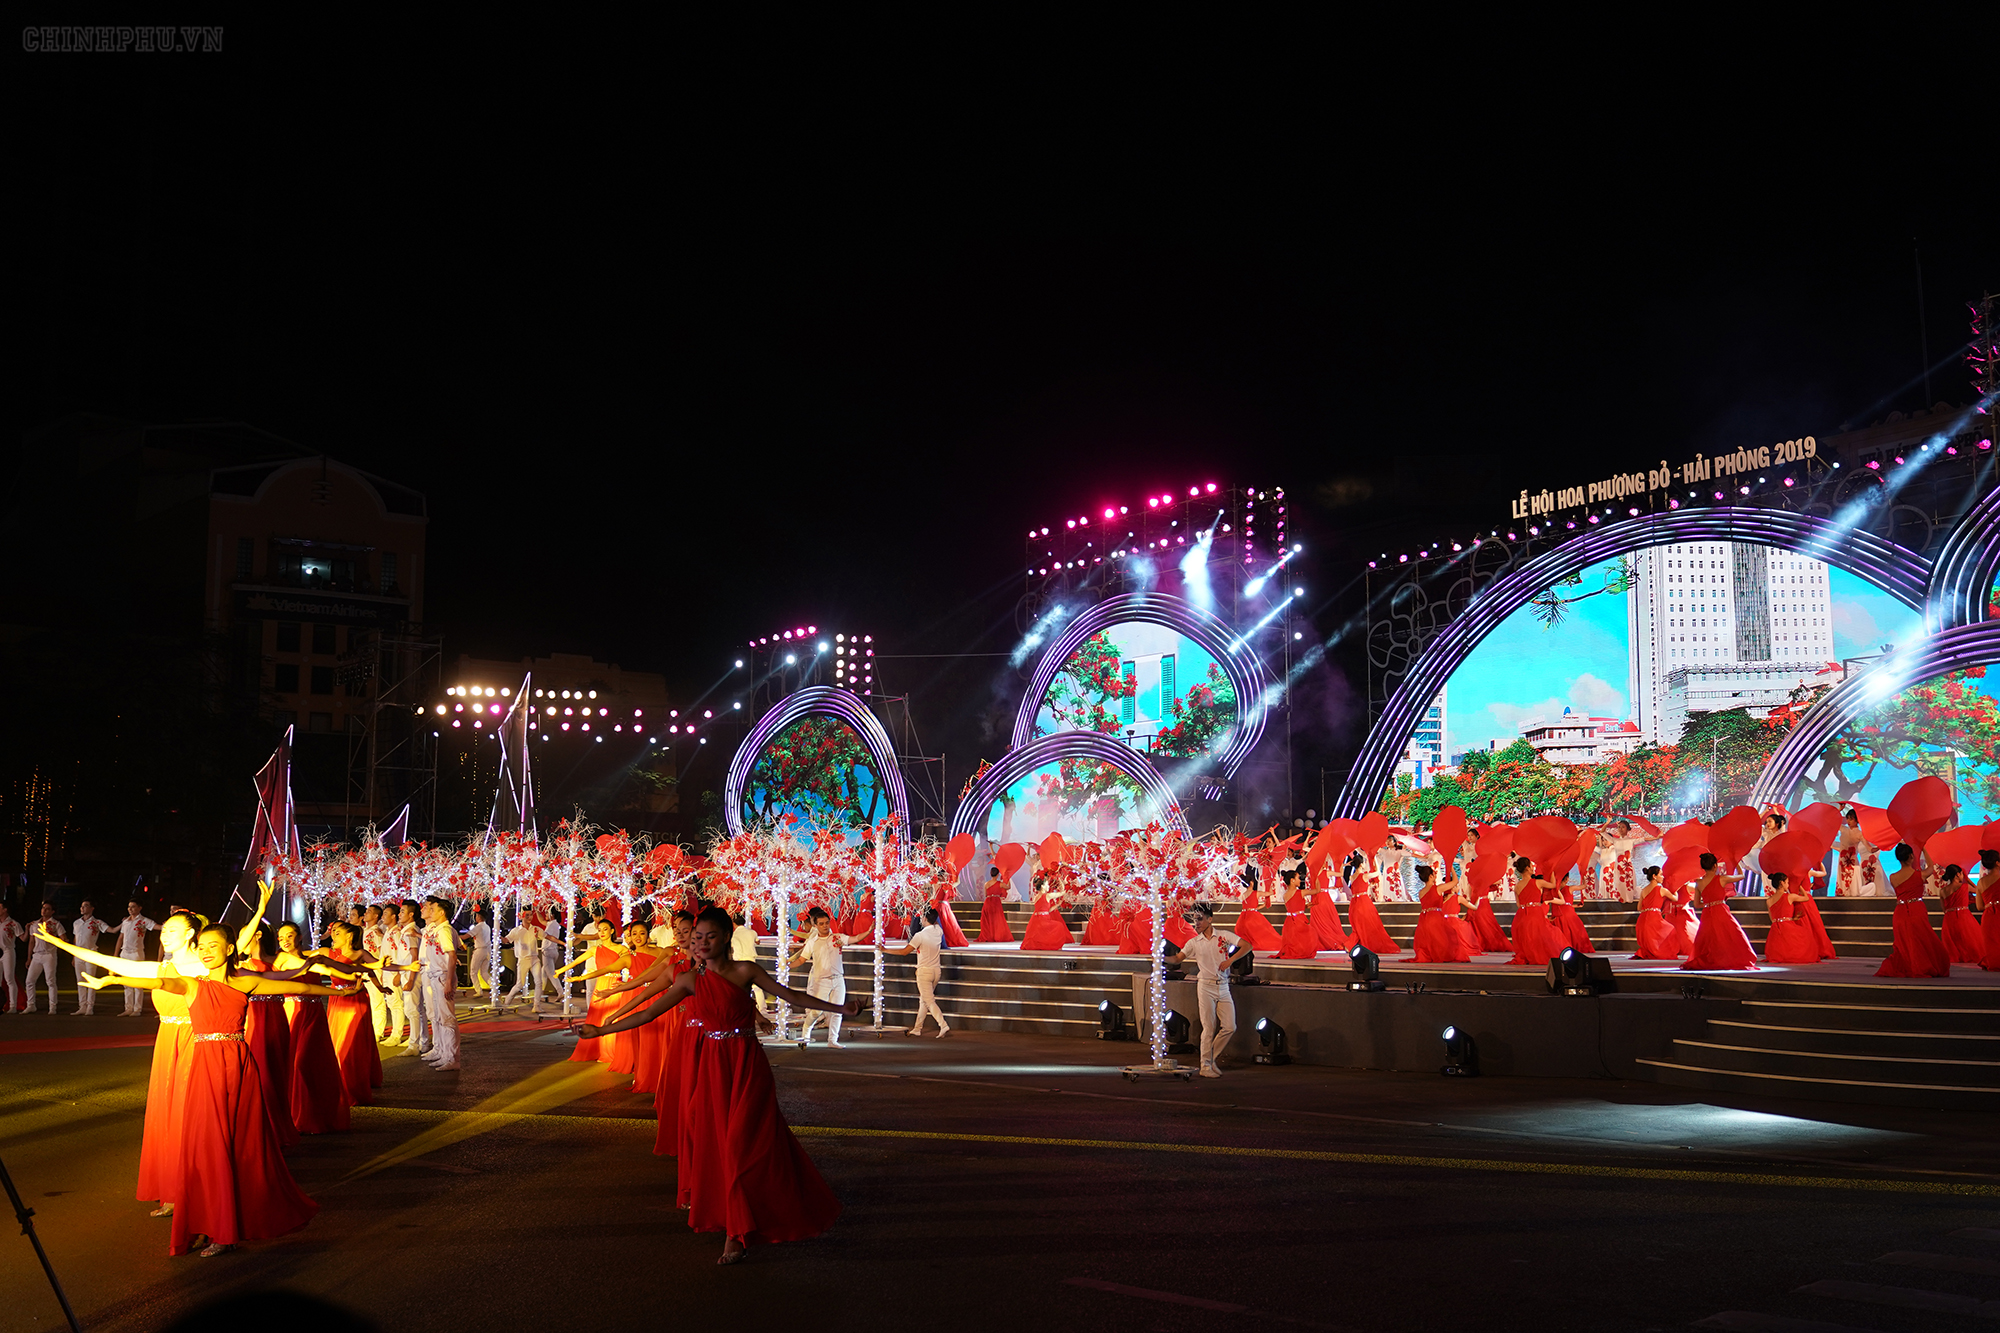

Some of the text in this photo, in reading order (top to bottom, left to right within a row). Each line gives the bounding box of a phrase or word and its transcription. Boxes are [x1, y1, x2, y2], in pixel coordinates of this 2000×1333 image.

[1512, 489, 1529, 519] LỄ
[1531, 488, 1554, 518] HỘI
[1557, 486, 1585, 510] HOA
[1588, 472, 1645, 502] PHƯỢNG
[1649, 460, 1670, 491] ĐỎ
[1683, 453, 1711, 484] HẢI
[1714, 446, 1770, 477] PHÒNG
[1774, 436, 1816, 465] 2019
[274, 599, 377, 618] Vietnam Airlines
